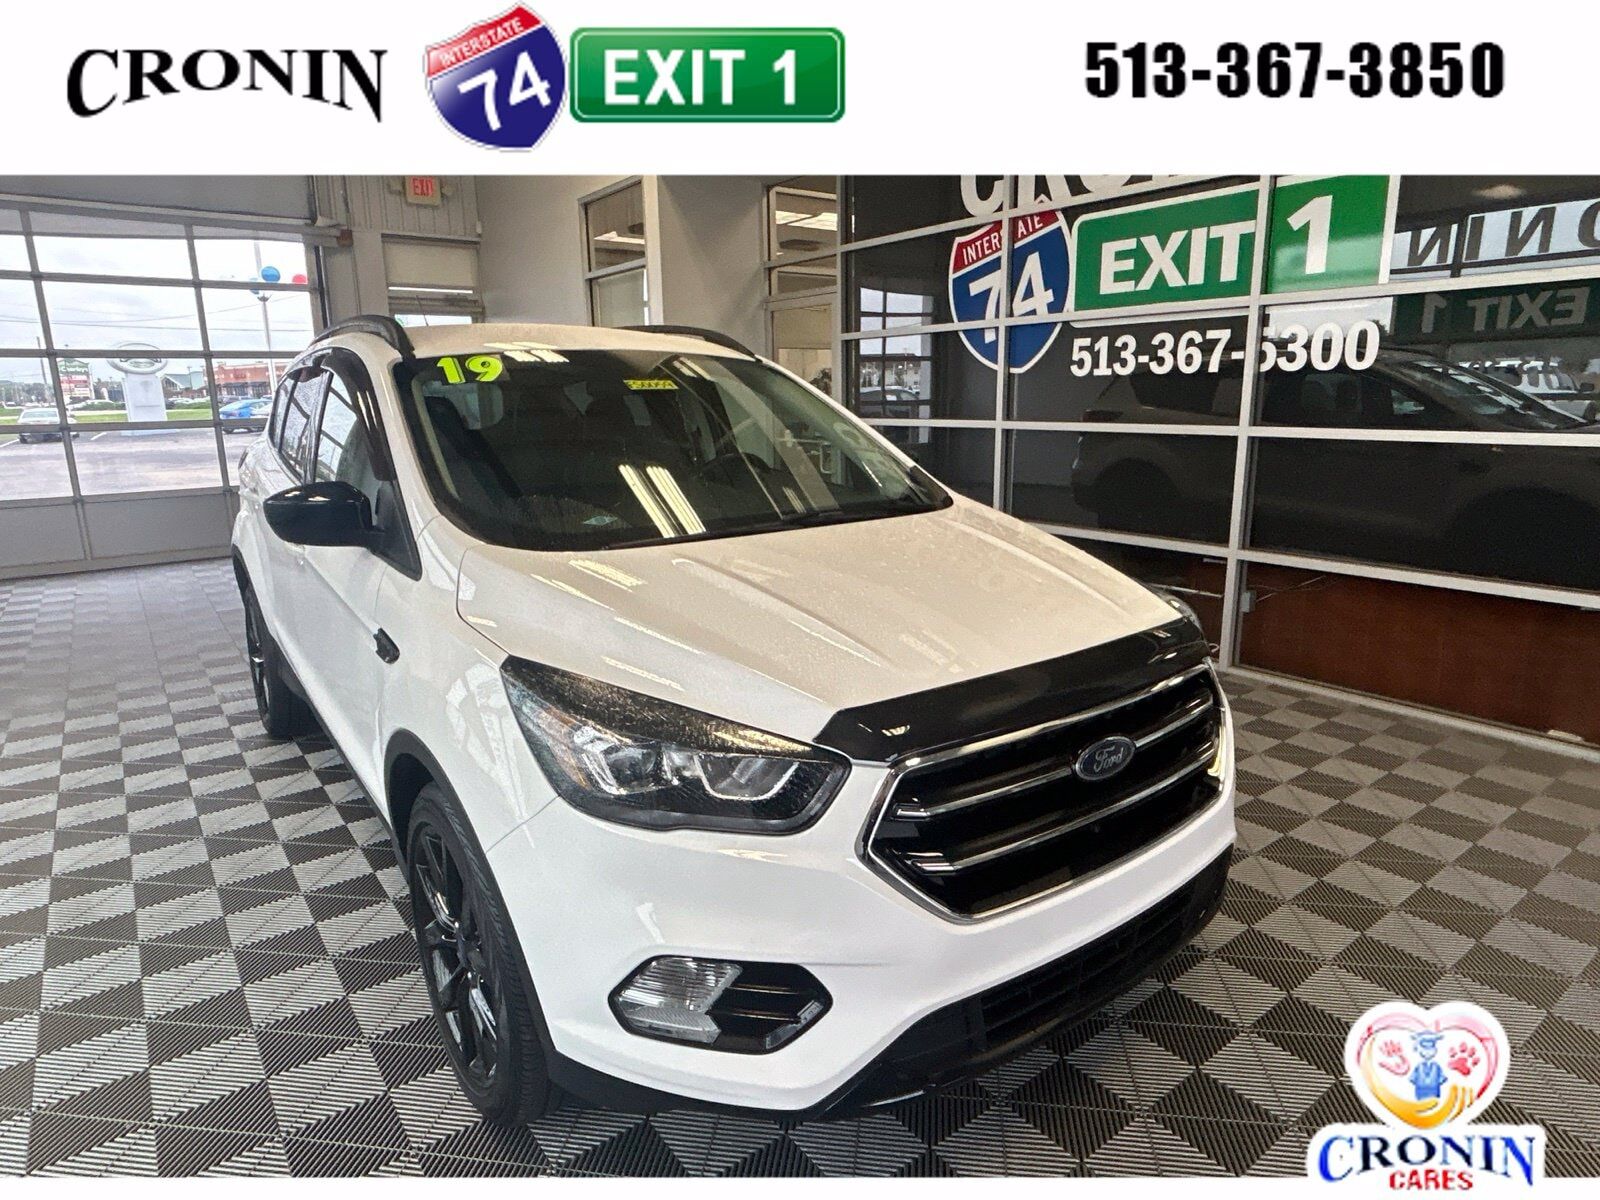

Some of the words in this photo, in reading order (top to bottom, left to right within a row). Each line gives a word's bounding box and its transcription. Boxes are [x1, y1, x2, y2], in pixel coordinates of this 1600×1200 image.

[1100, 219, 1257, 295] EXIT
[1287, 195, 1333, 275] 1
[969, 251, 1054, 344] 74
[437, 355, 503, 383] 19
[1093, 745, 1124, 773] Ford
